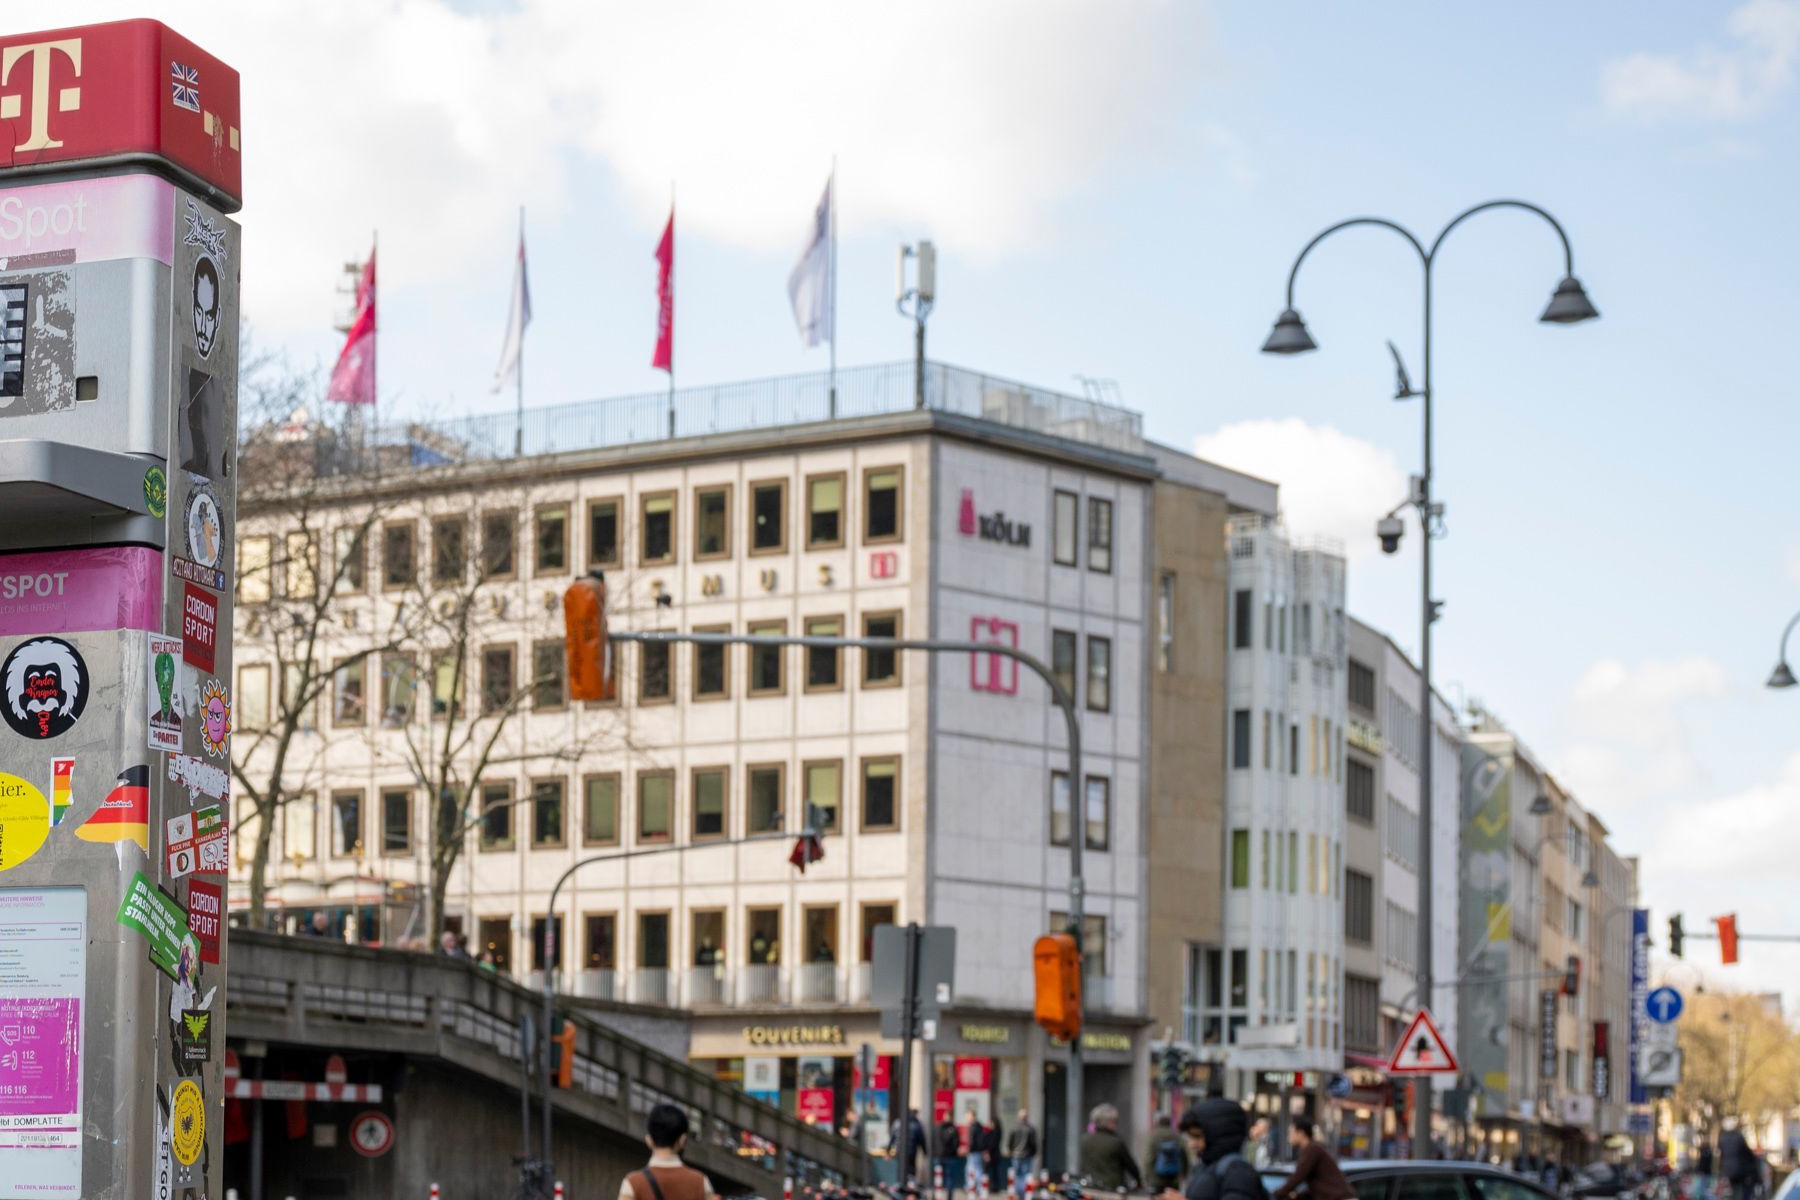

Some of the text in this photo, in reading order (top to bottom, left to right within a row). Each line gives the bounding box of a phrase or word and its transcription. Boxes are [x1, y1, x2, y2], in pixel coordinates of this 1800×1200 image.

[2, 38, 82, 152] T
[186, 594, 215, 625] CORDON
[185, 617, 214, 646] SPORT
[135, 880, 147, 892] EIN
[130, 892, 152, 915] PASST
[190, 891, 219, 915] CORDON
[190, 913, 218, 937] SPORT
[22, 1025, 36, 1034] 110
[742, 1025, 842, 1045] SOUVENIRS
[22, 1050, 35, 1060] 112
[0, 1084, 28, 1094] 116 116
[14, 1116, 63, 1126] DOMPLATTE
